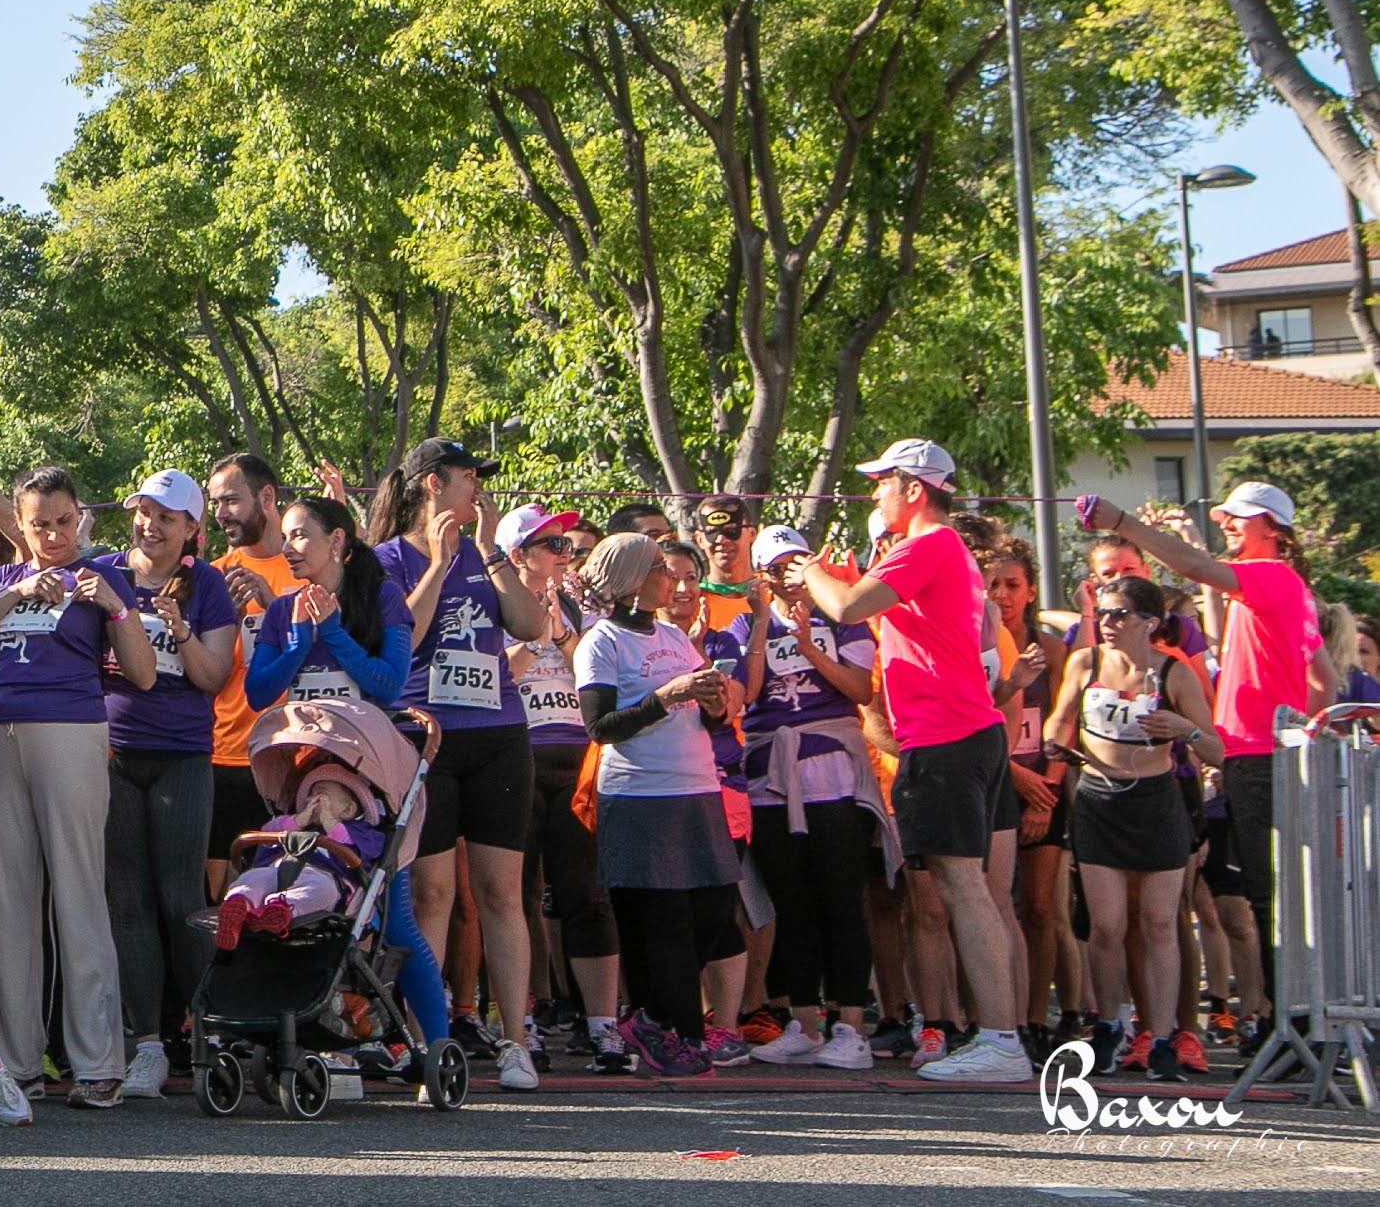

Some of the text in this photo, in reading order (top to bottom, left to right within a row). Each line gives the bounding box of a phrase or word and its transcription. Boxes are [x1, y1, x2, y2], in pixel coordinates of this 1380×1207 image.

[775, 637, 827, 661] 443
[441, 665, 494, 690] 7552
[529, 691, 580, 711] 4486
[1105, 703, 1129, 724] 71
